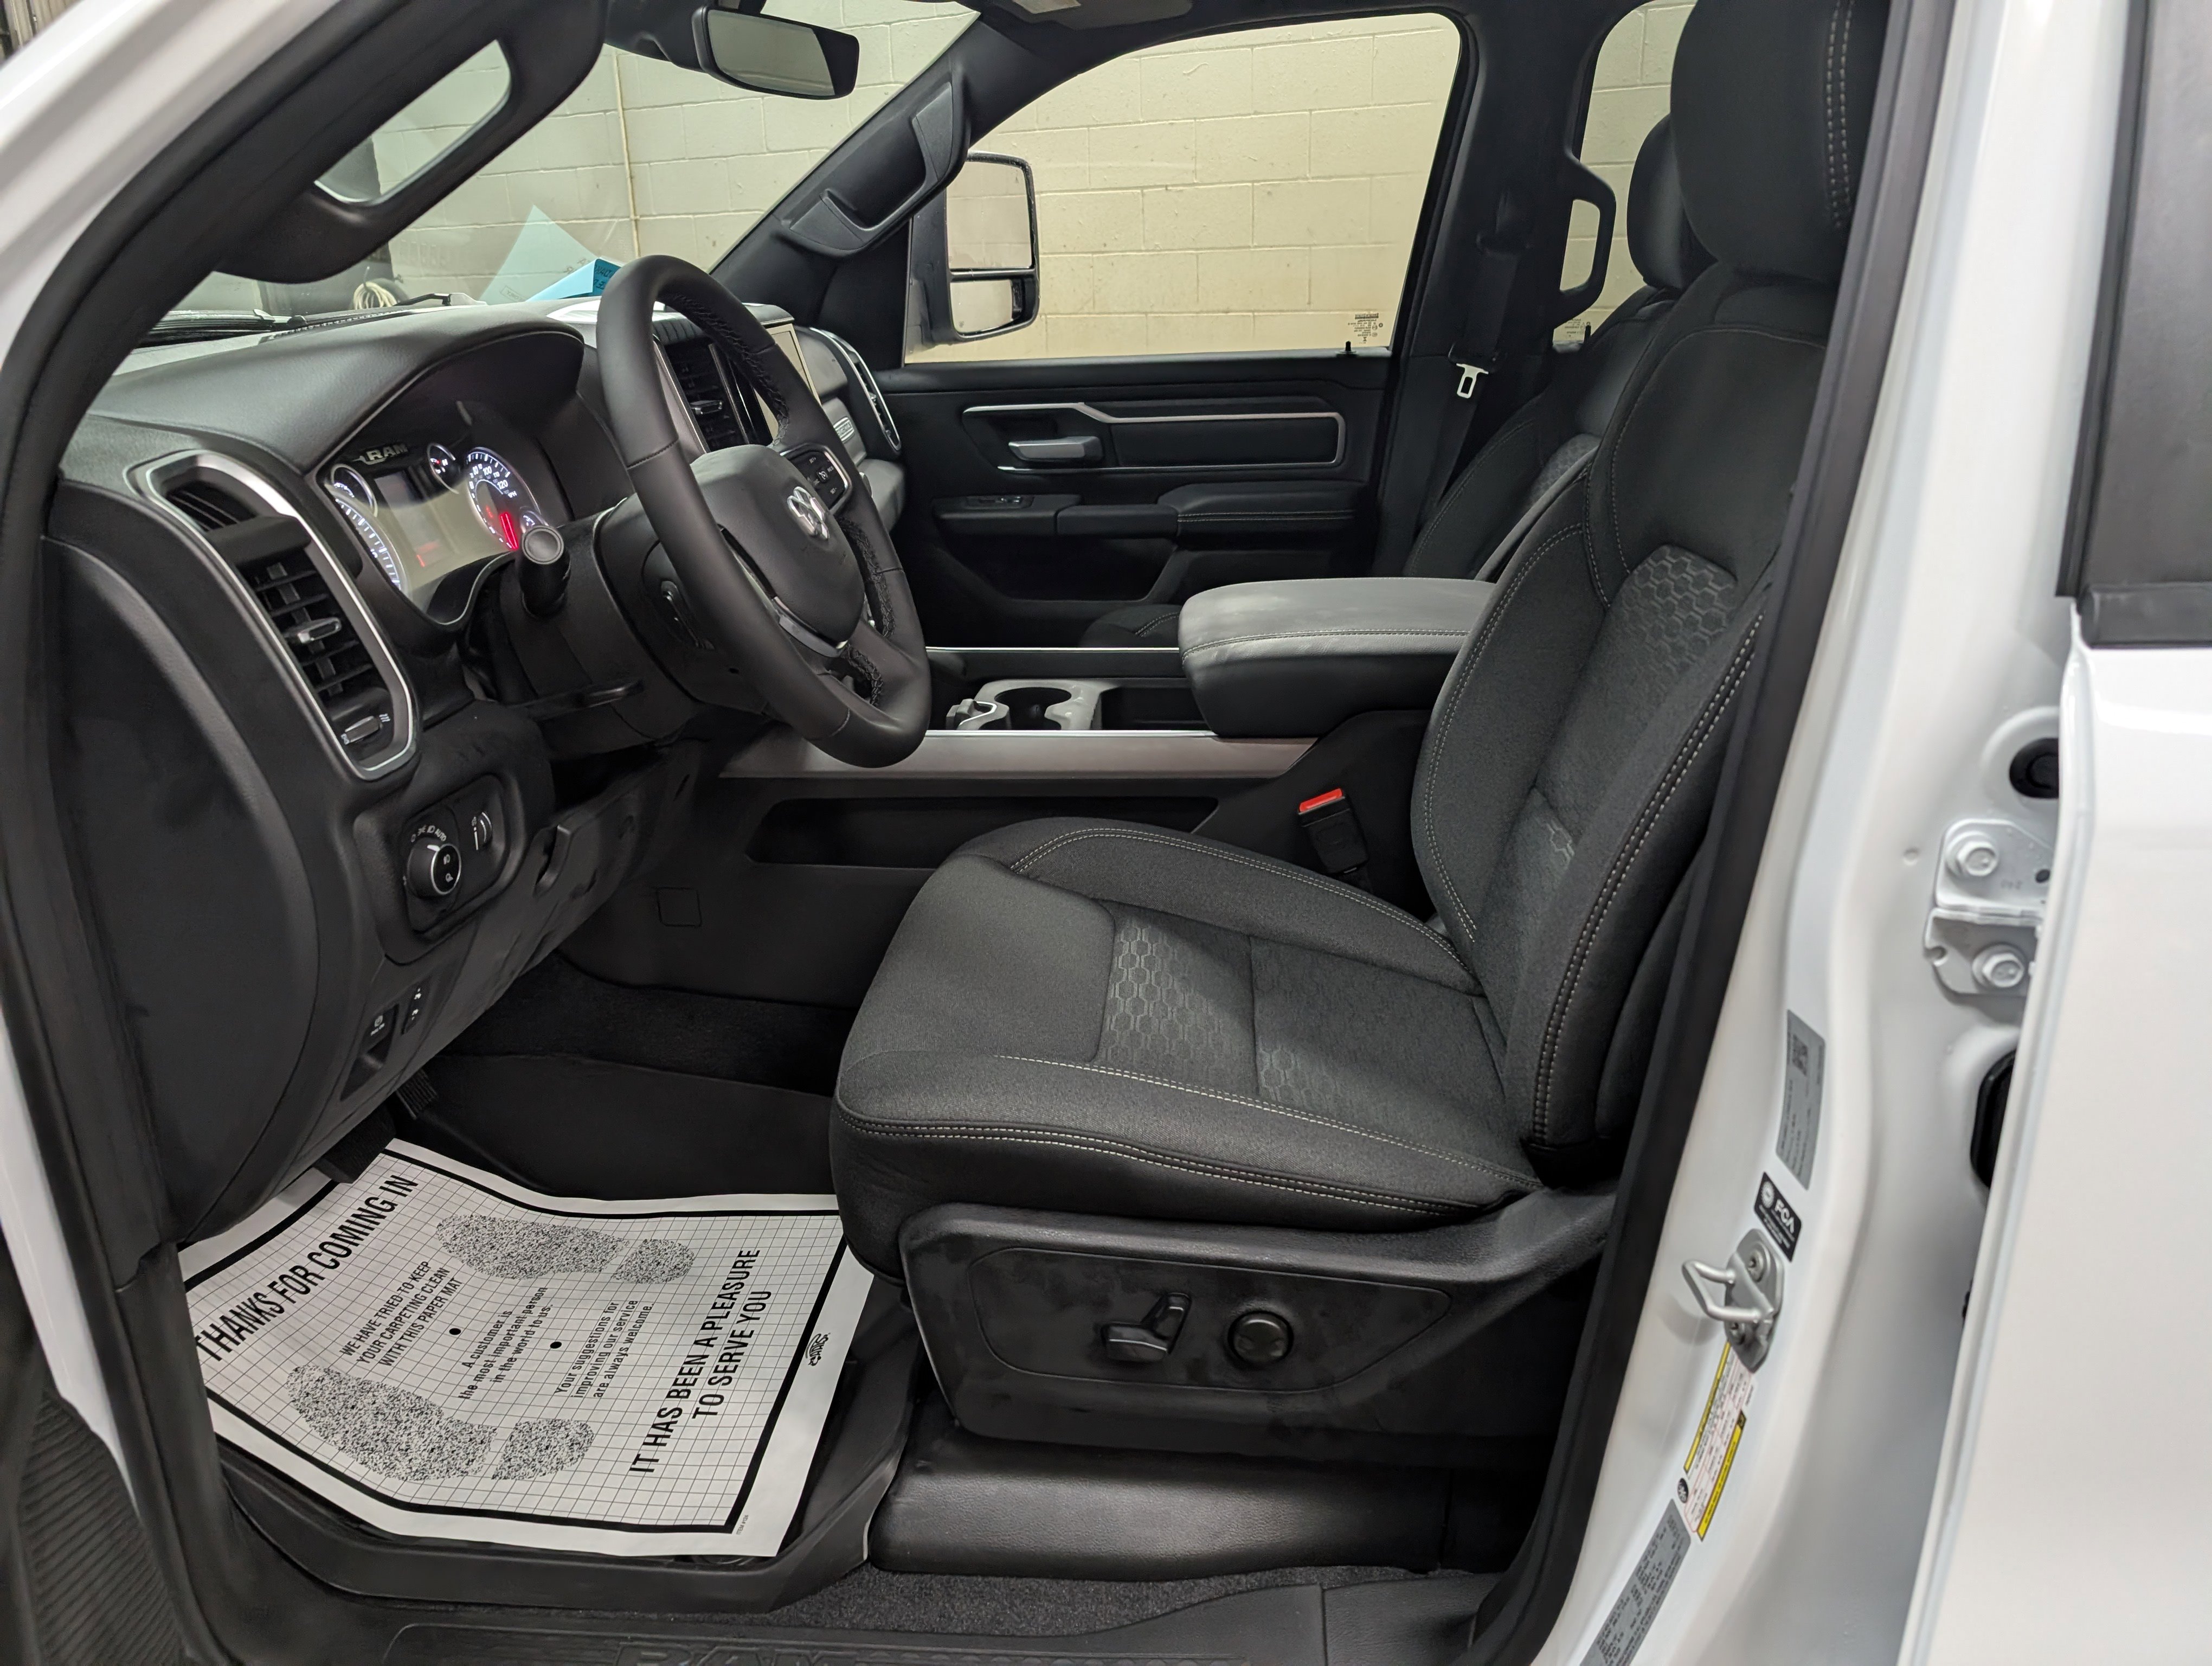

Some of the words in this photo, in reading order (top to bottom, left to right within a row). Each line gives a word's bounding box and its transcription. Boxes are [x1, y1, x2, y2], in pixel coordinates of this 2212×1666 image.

[366, 444, 408, 461] RAM
[483, 466, 492, 476] 100
[497, 479, 509, 489] 120
[434, 829, 447, 841] AUTO
[1774, 1199, 1795, 1234] FCA
[195, 1292, 285, 1362] THANKS
[267, 1265, 325, 1304] FOR
[307, 1196, 398, 1270] COMING
[378, 1174, 419, 1197] IN
[700, 1250, 761, 1330] PLEASURE
[339, 1341, 361, 1356] WE
[353, 1319, 382, 1343] HAVE
[374, 1295, 403, 1319] TRIED
[397, 1281, 415, 1294] TO
[408, 1261, 432, 1282] KEEP
[356, 1340, 387, 1364] YOUR
[380, 1293, 428, 1340] CARPETING
[421, 1267, 451, 1294] CLEAN
[378, 1342, 407, 1367] WITH
[399, 1323, 425, 1343] THIS
[417, 1296, 449, 1323] PAPER
[441, 1277, 463, 1296] MAT
[736, 1291, 772, 1324] YOU
[458, 1385, 478, 1399] the
[473, 1360, 497, 1382] most
[488, 1316, 528, 1357] important
[522, 1287, 548, 1315] person
[470, 1319, 503, 1359] customer
[498, 1310, 513, 1318] is
[490, 1374, 506, 1383] in
[498, 1357, 517, 1371] the
[512, 1329, 536, 1355] world
[528, 1319, 543, 1328] to
[538, 1304, 554, 1318] us.
[554, 1373, 577, 1394] Your
[572, 1316, 611, 1370] suggestions
[603, 1302, 619, 1314] for
[570, 1351, 611, 1398] improving
[603, 1334, 619, 1349] our
[613, 1300, 638, 1332] service
[593, 1382, 609, 1398] are
[604, 1347, 629, 1379] always
[623, 1303, 654, 1344] welcome.
[693, 1336, 718, 1348] A
[707, 1329, 755, 1387] SERVE
[666, 1354, 710, 1399] BEEN
[643, 1407, 683, 1447] HAS
[692, 1394, 725, 1419] TO
[629, 1453, 660, 1473] IT
